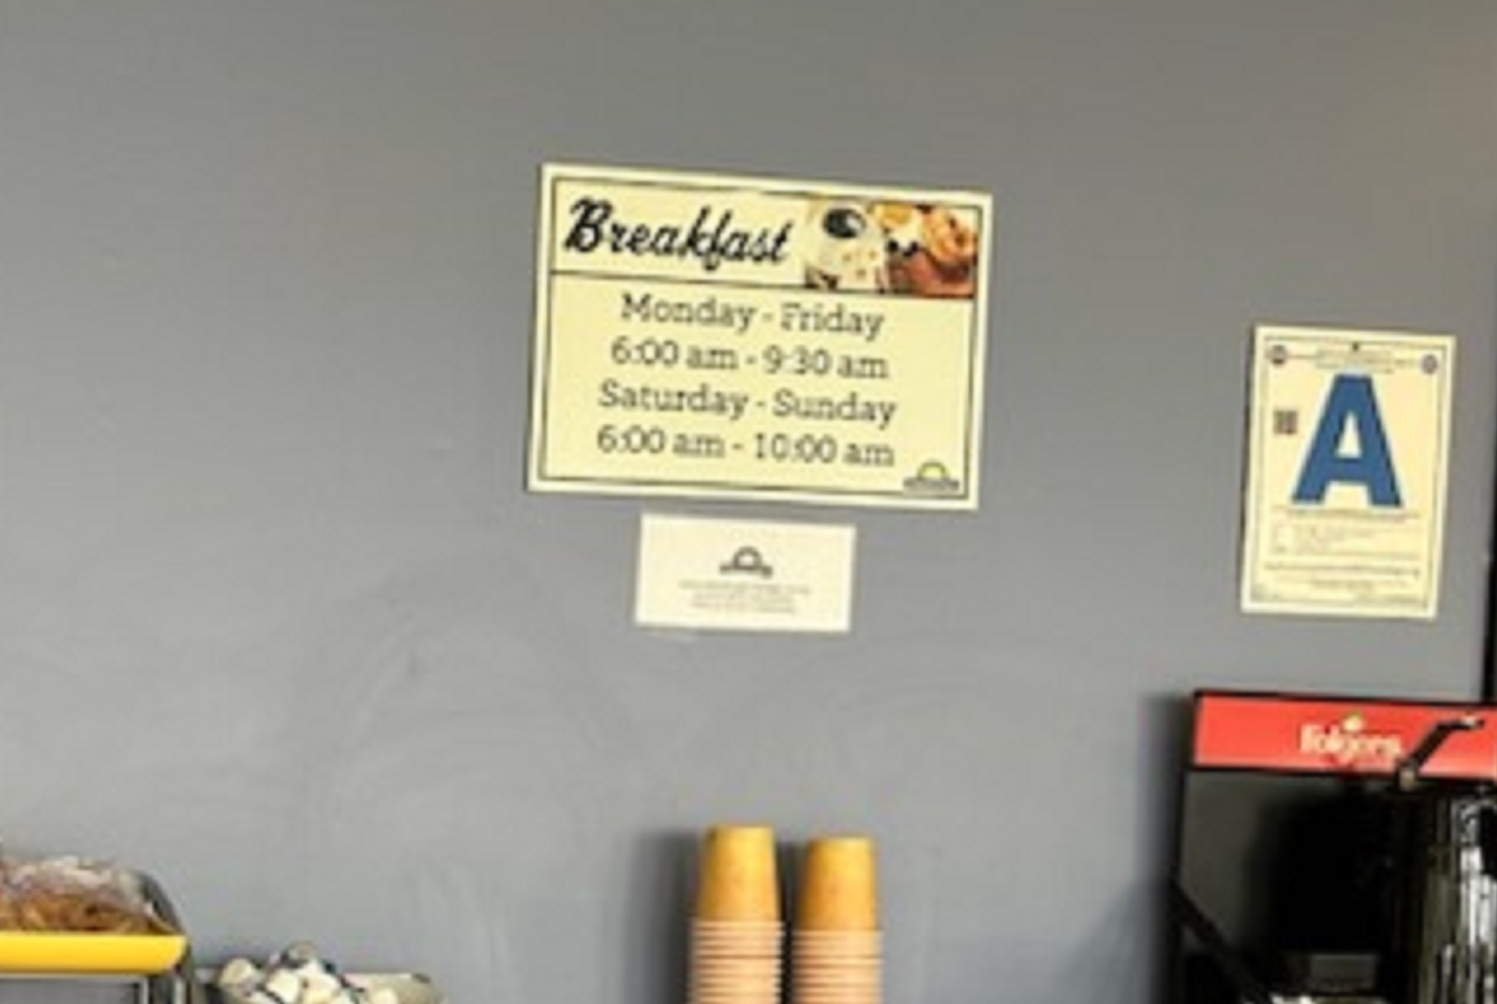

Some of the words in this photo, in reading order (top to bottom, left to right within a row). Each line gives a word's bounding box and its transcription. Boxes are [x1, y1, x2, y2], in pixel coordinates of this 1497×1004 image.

[564, 196, 793, 271] Breakfast
[621, 292, 757, 334] Monday
[780, 302, 885, 342] Friday
[610, 336, 679, 367] 6:00
[686, 345, 739, 370] am
[762, 345, 832, 376] 9:30
[837, 354, 889, 379] am
[598, 378, 749, 421] Saturday
[771, 388, 896, 431] Sunday
[597, 424, 666, 454] 6:00
[672, 432, 725, 458] am
[755, 431, 838, 464] 10:00
[843, 441, 895, 467] am
[1292, 374, 1403, 508] A
